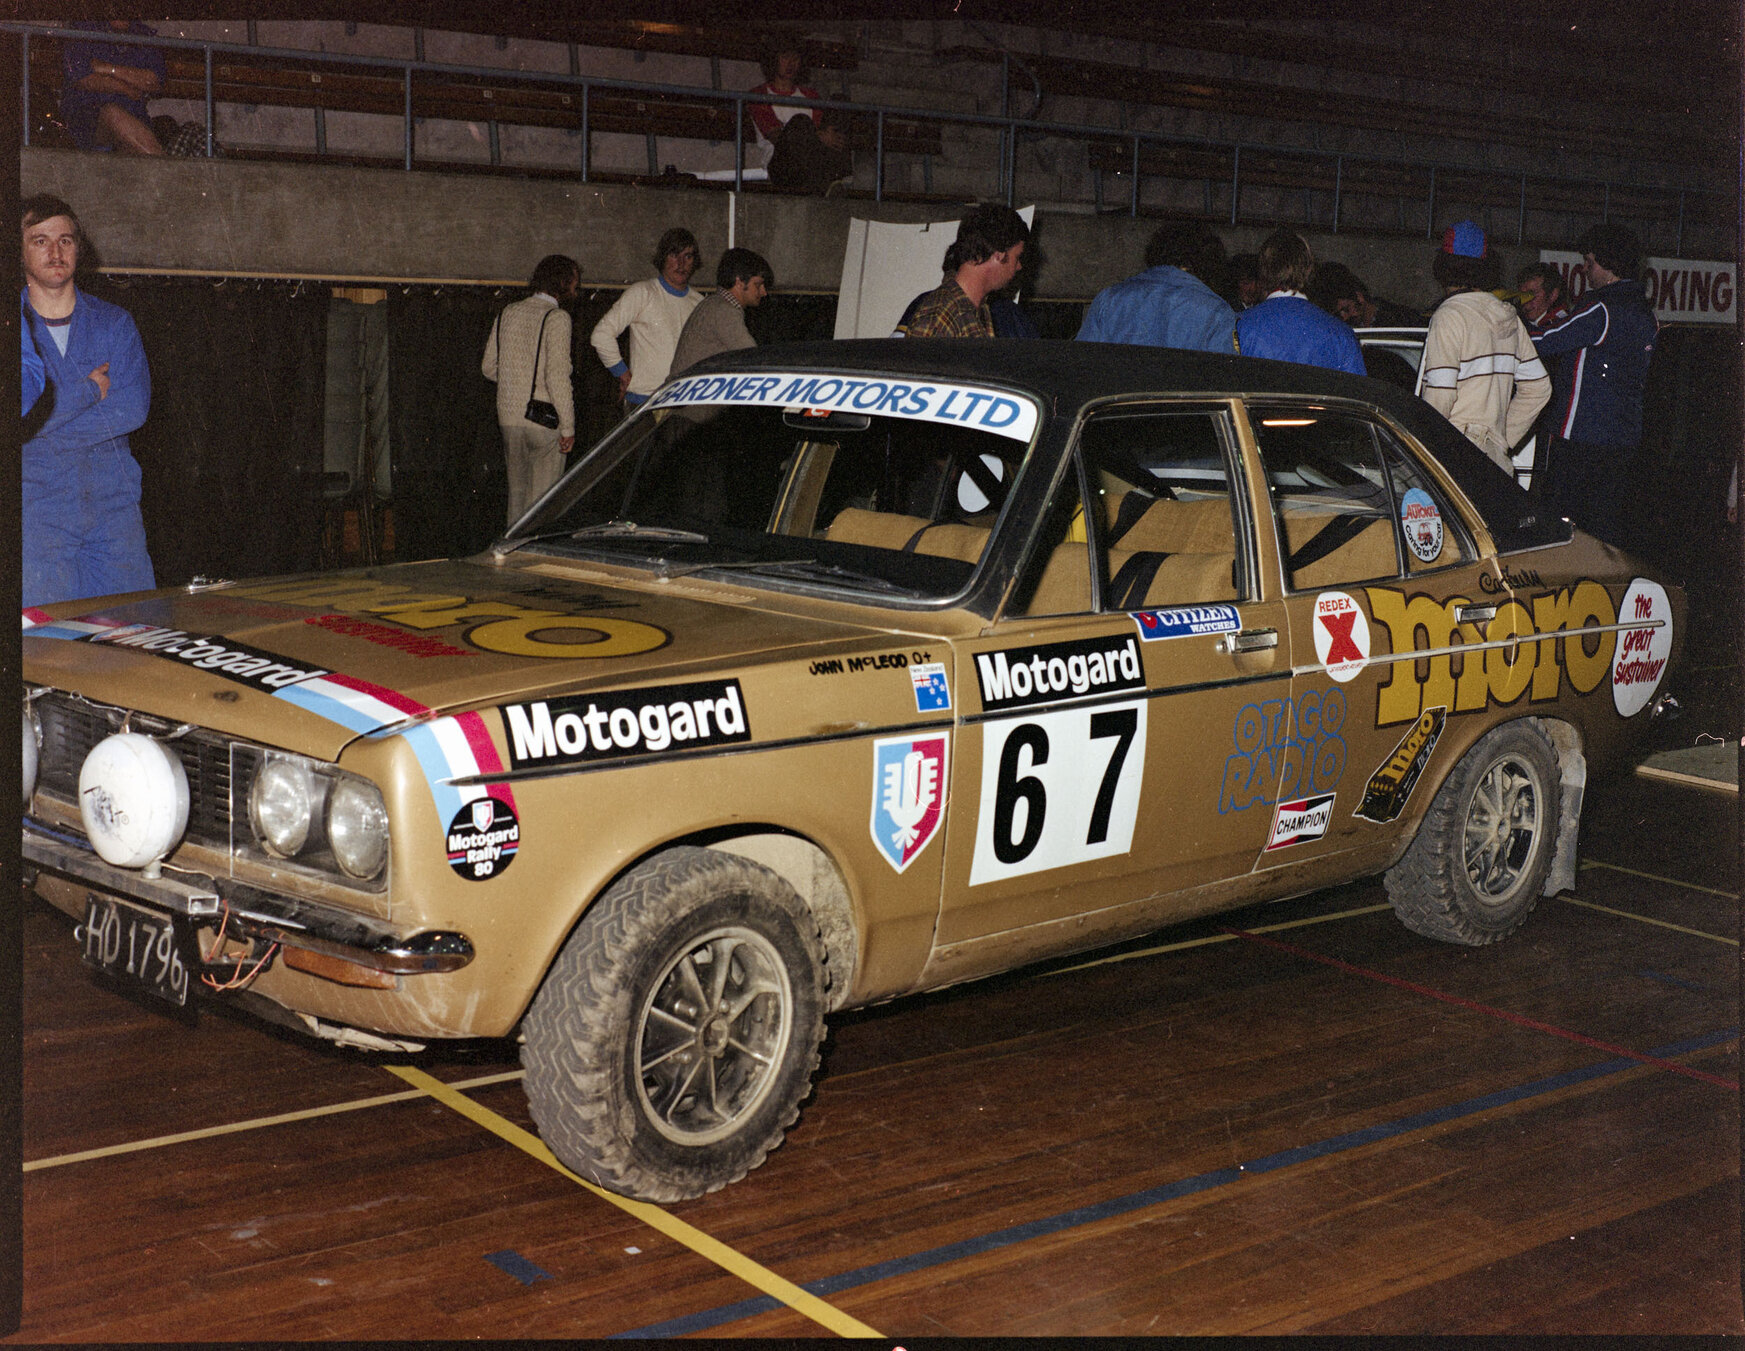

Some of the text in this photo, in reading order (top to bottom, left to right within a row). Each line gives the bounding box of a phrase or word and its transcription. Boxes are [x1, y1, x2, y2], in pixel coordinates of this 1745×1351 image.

[651, 377, 1021, 429] GARDNER MOTORS LTD
[1156, 605, 1234, 627] CITIZEN
[1318, 598, 1352, 613] REDEX
[1635, 593, 1652, 619] the
[1190, 620, 1236, 633] WATCHES
[1621, 626, 1655, 660] great
[113, 628, 329, 688] Motogard
[809, 659, 845, 676] JOHN
[977, 638, 1141, 702] Motogard
[1364, 577, 1617, 730] moro
[1614, 650, 1666, 686] sustainer
[505, 685, 748, 762] Motogard
[1234, 687, 1347, 755] OTAGO
[1377, 711, 1434, 785] moro
[992, 707, 1139, 865] 67
[1218, 733, 1347, 815] RADIO
[448, 824, 519, 853] Motogard
[1276, 810, 1328, 835] CHAMPION
[467, 845, 502, 864] Rally
[474, 860, 494, 877] 80
[126, 921, 184, 991] 1796
